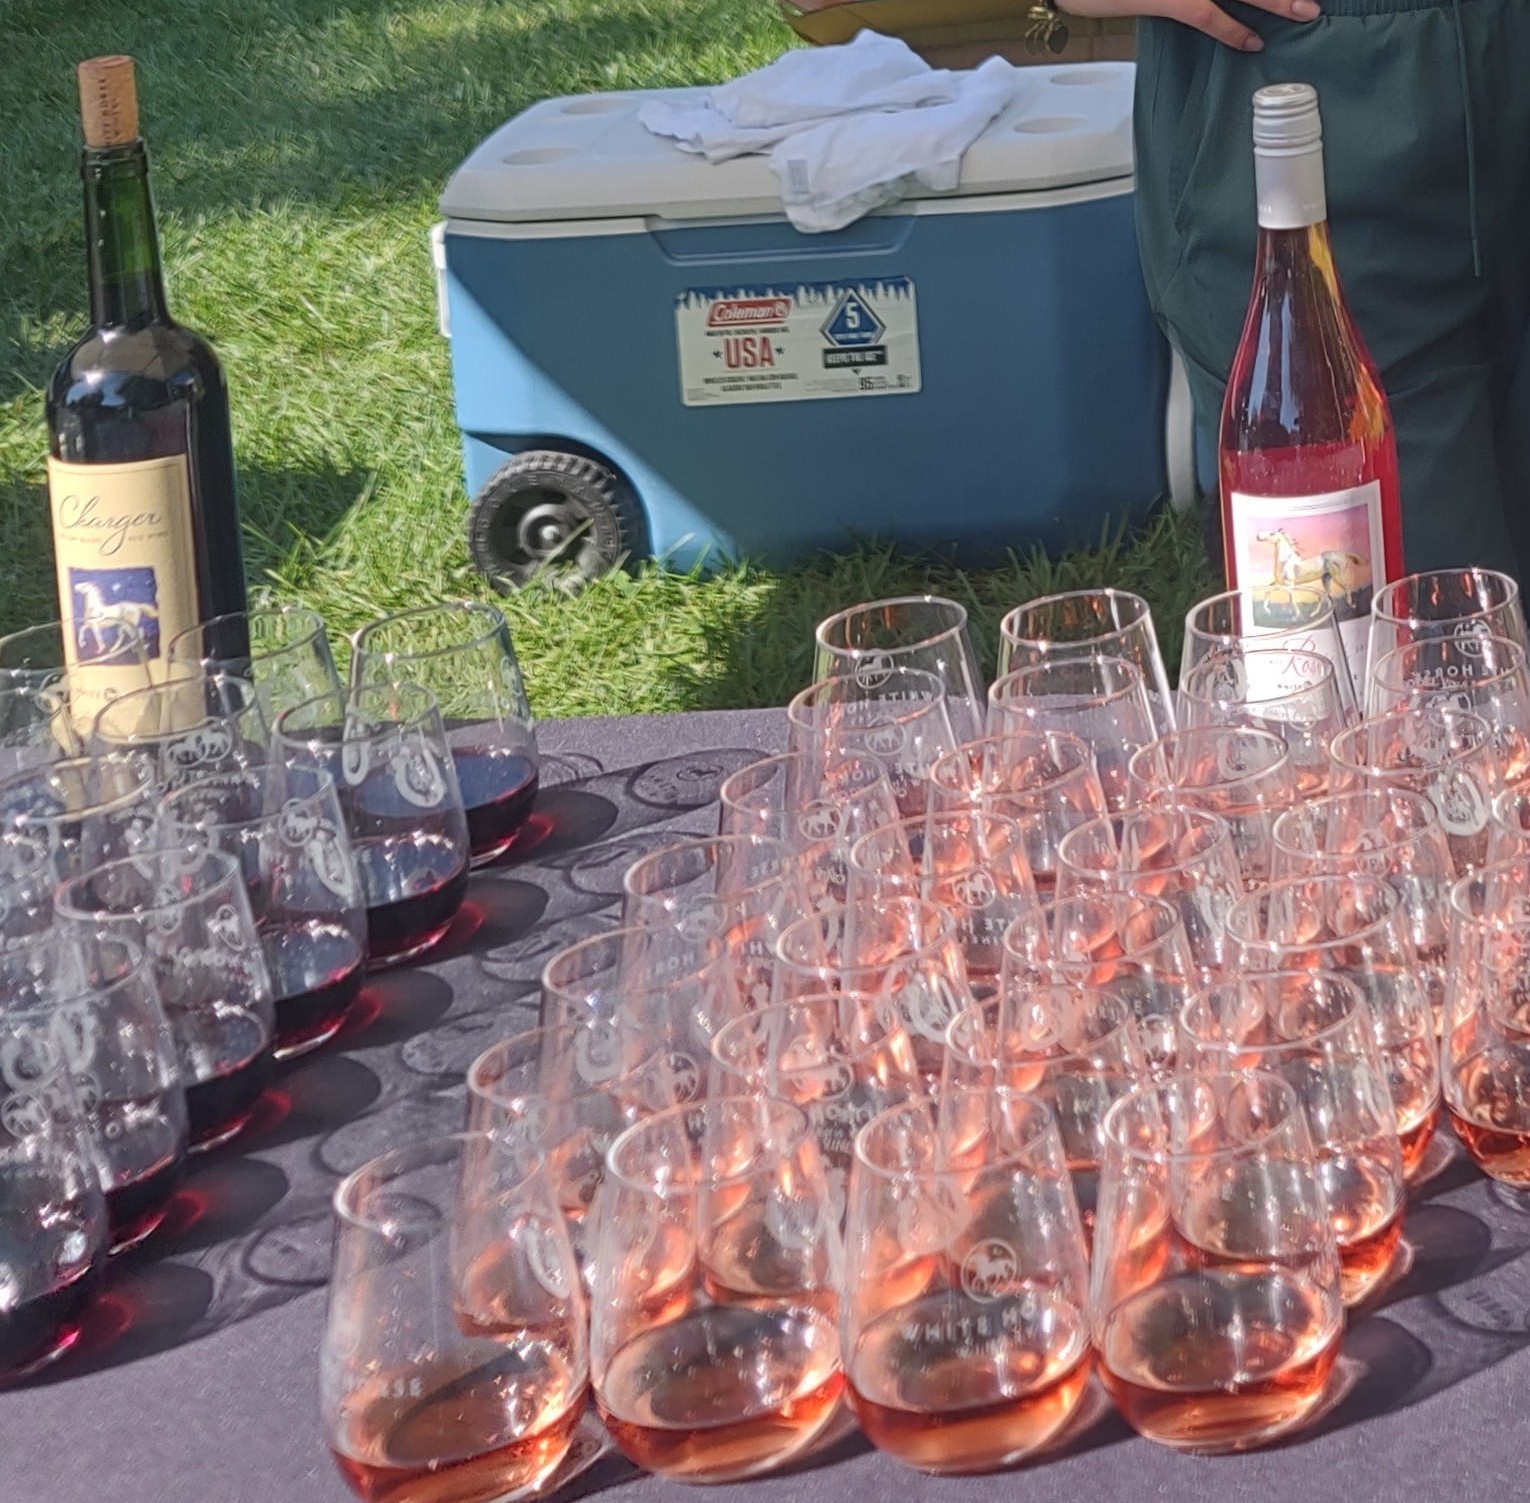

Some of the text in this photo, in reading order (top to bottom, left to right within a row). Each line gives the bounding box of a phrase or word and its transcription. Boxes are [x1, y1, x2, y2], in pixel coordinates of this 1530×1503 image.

[713, 303, 775, 322] Coleman
[845, 302, 860, 329] 5
[723, 337, 776, 369] USA
[59, 494, 162, 556] Charger
